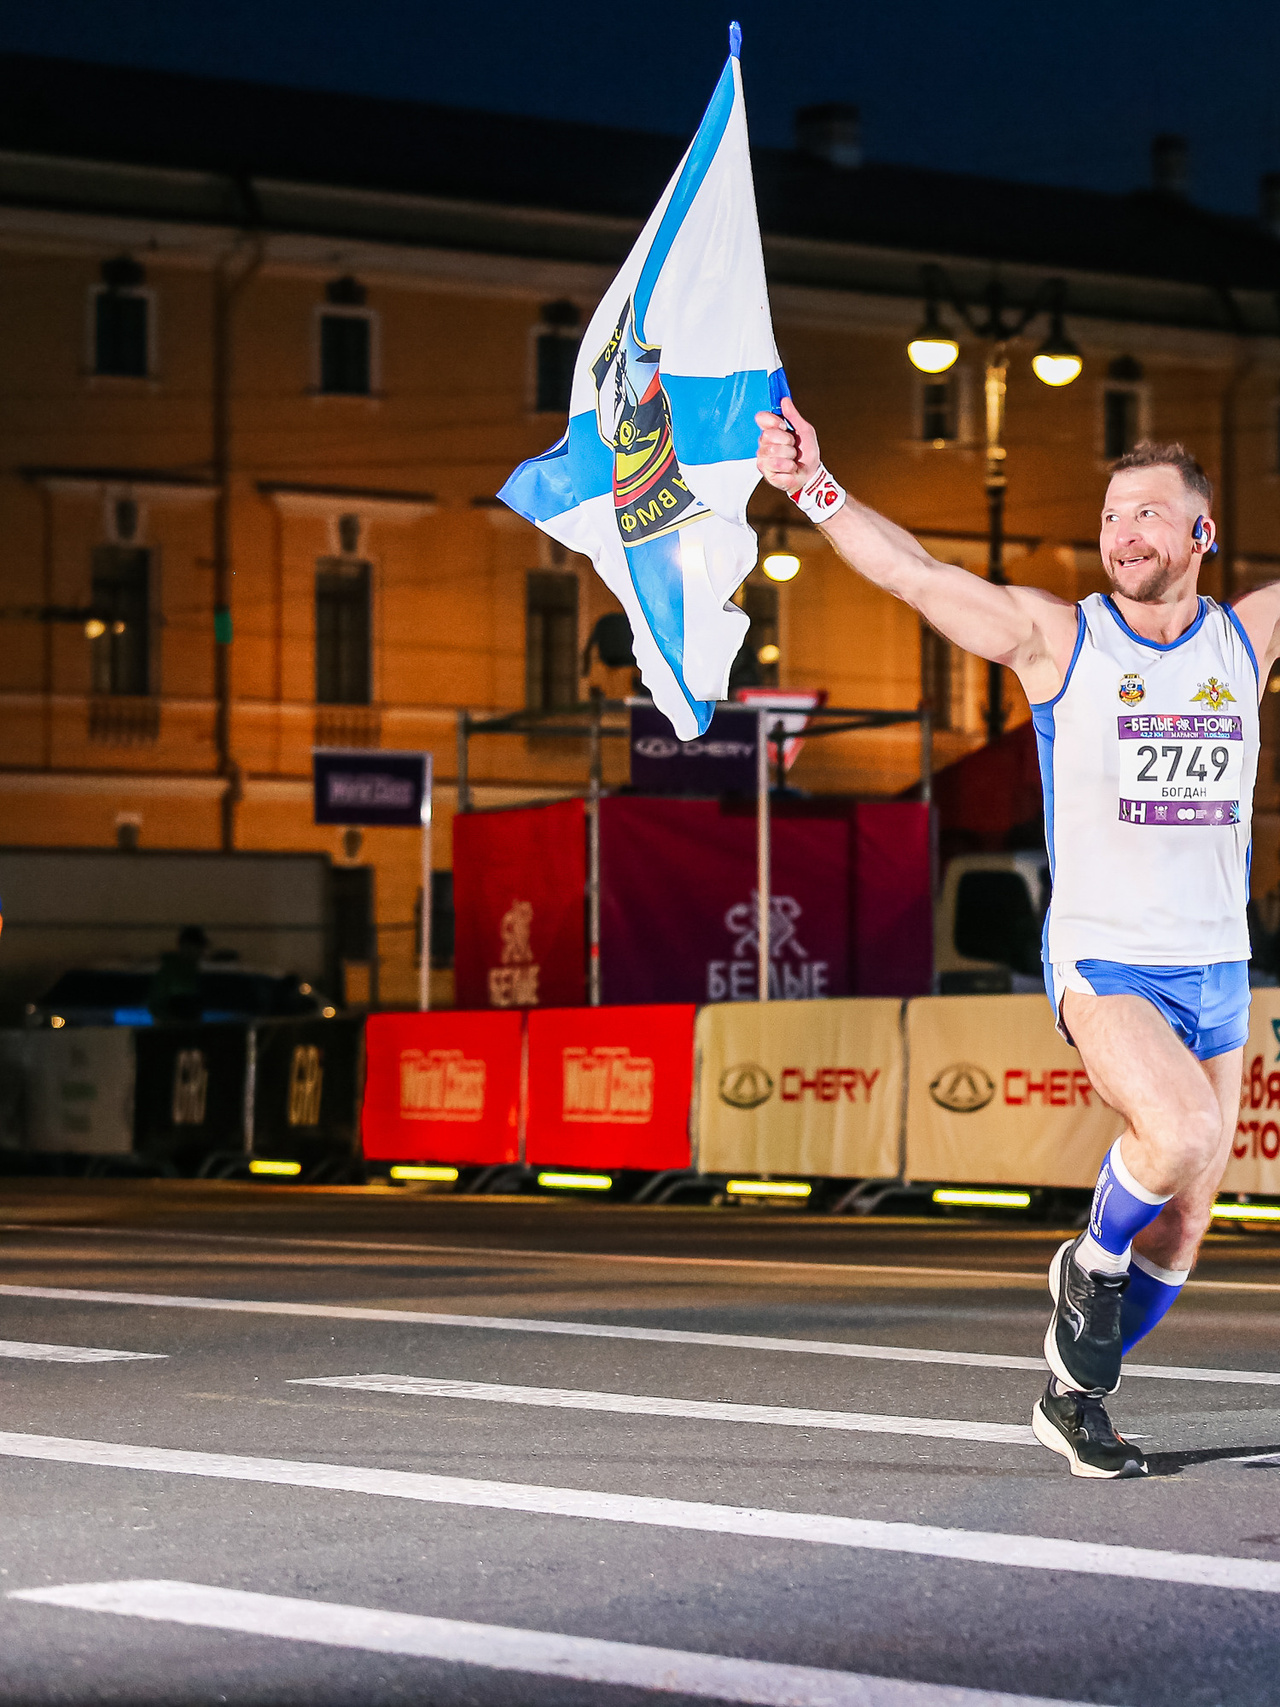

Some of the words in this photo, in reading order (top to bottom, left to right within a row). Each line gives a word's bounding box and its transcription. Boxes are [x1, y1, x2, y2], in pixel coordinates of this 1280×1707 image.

[1131, 717, 1174, 732] БЕЛЫЕ
[1194, 717, 1233, 732] НОЧИ
[1137, 745, 1230, 782] 2749
[1162, 787, 1207, 799] БОГДАН
[782, 1067, 881, 1103] CHERY
[1003, 1069, 1092, 1107] CHER
